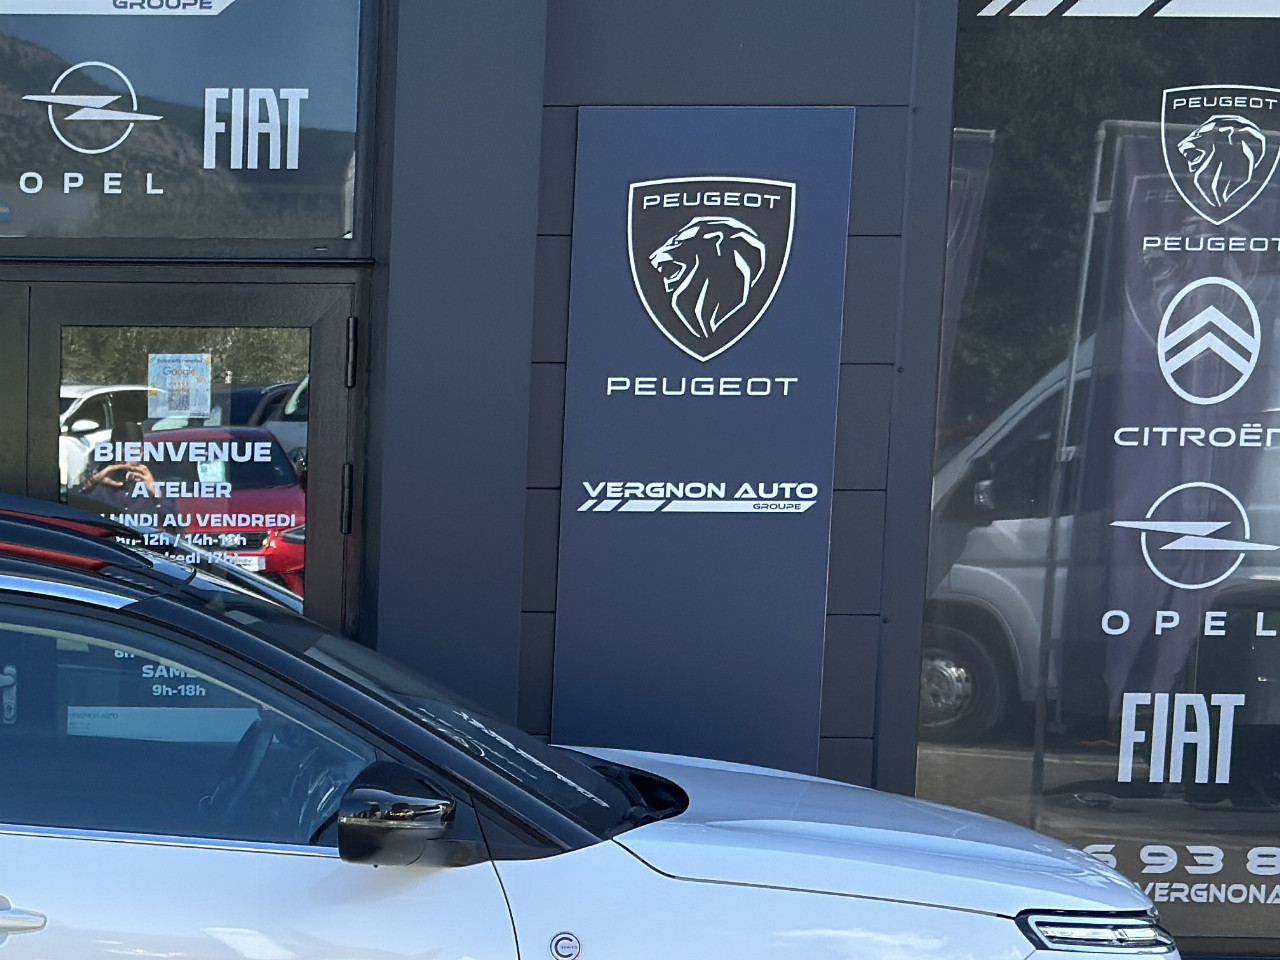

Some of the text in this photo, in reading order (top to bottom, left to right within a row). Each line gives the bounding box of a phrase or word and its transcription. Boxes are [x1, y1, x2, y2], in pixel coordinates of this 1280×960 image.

[1173, 96, 1278, 110] PEUGEOT
[204, 88, 309, 170] FIAT
[19, 171, 164, 195] OPEL
[643, 191, 781, 209] PEUGEOT
[606, 377, 799, 396] PEUGEOT
[94, 441, 272, 463] BIENVENUE
[131, 481, 232, 499] ATELIER
[582, 481, 818, 499] VERGNON AUTO
[100, 513, 296, 528] UNDI AU VENDREDI
[152, 684, 206, 697] 9h-18h
[1117, 692, 1246, 785] FIAT
